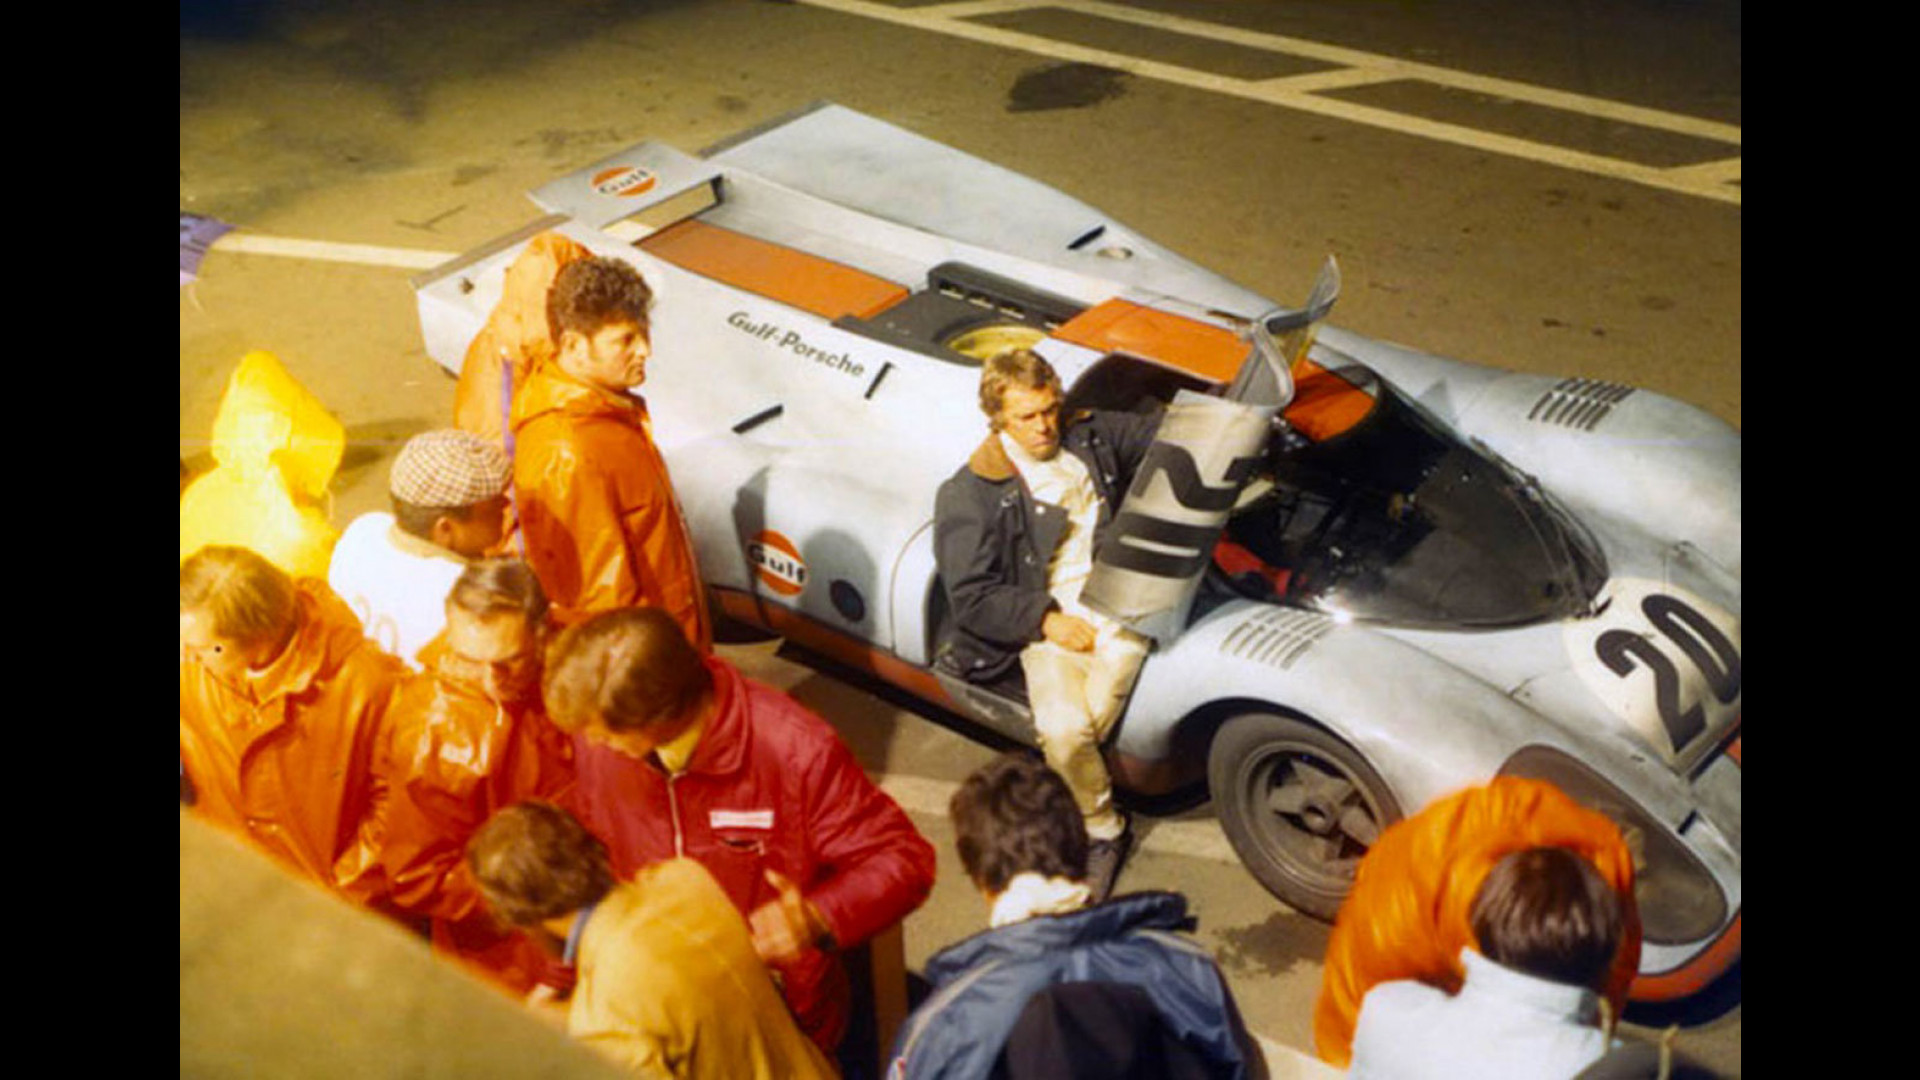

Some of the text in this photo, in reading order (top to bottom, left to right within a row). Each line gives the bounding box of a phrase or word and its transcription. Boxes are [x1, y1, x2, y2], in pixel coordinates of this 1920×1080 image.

[598, 167, 650, 195] Gulf
[727, 311, 864, 376] Gulf-Porsche
[747, 542, 805, 583] Gulf
[1595, 594, 1741, 753] 20
